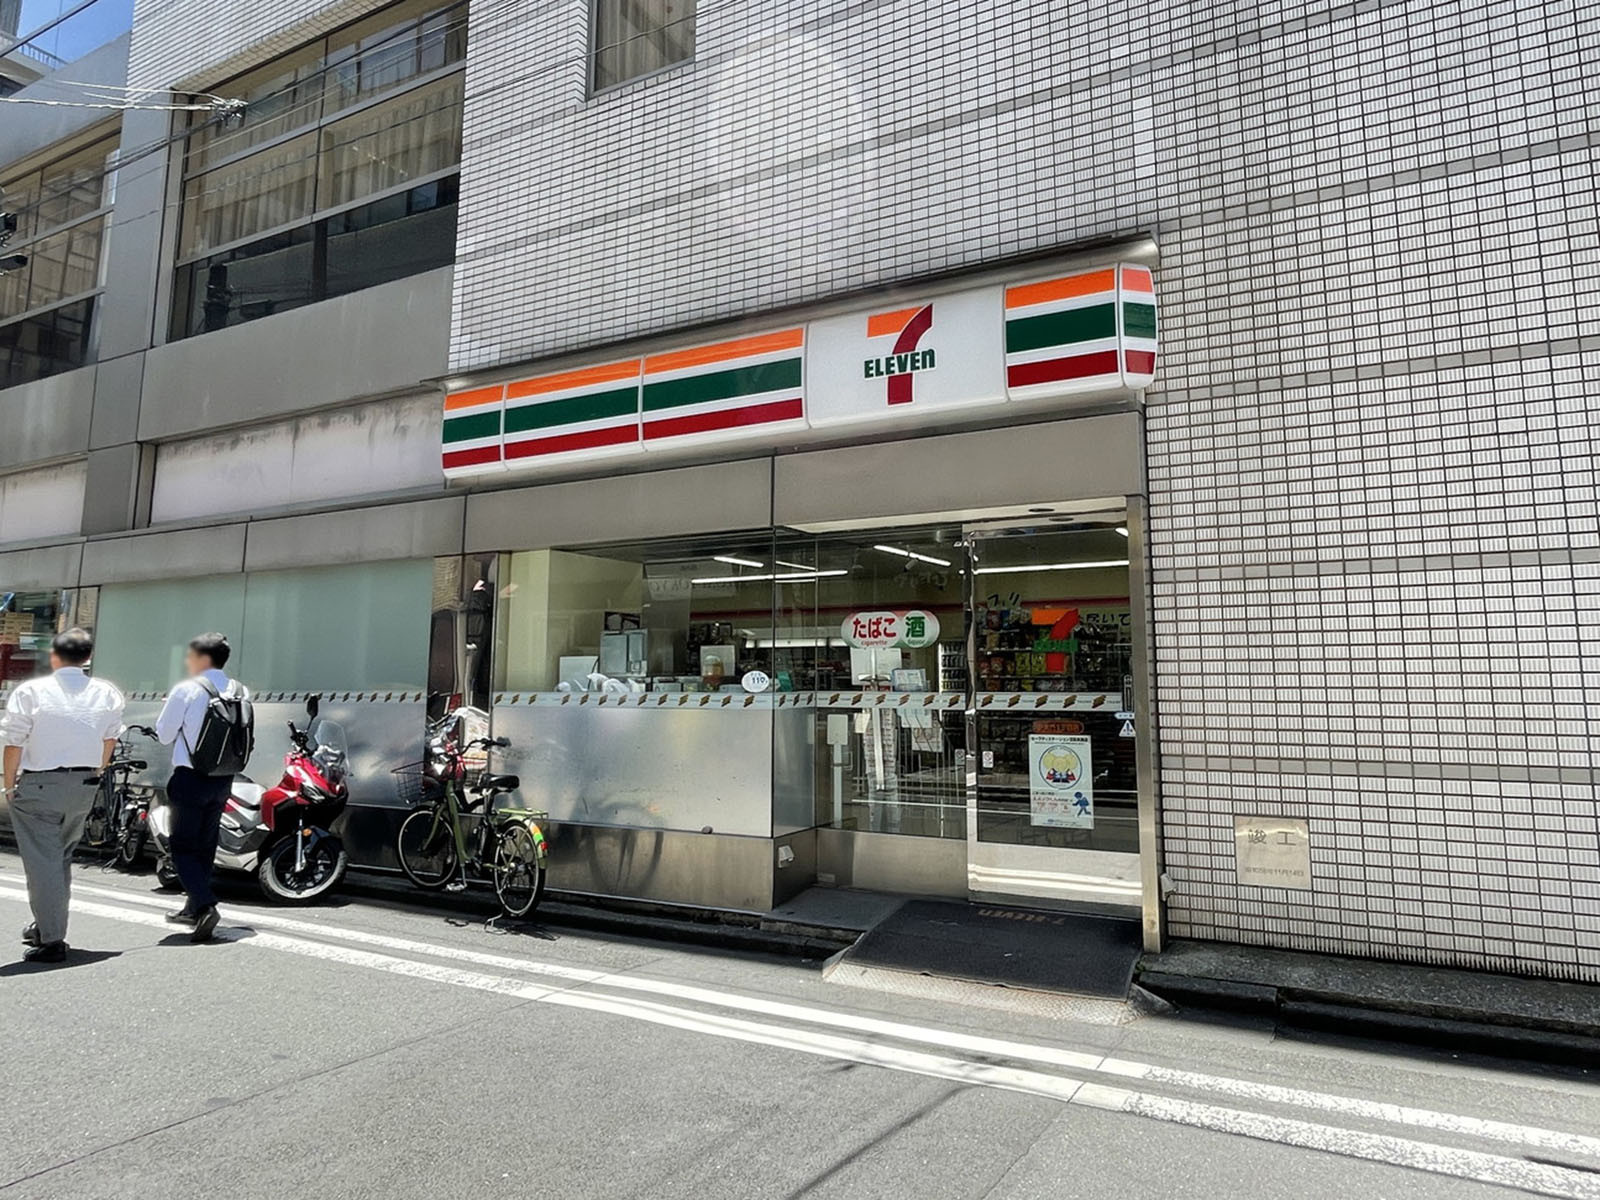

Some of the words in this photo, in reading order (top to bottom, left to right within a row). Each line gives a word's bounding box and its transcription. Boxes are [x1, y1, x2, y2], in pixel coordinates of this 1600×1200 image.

[867, 303, 933, 405] 7
[852, 617, 897, 639] たばこ
[905, 616, 926, 638] 酒
